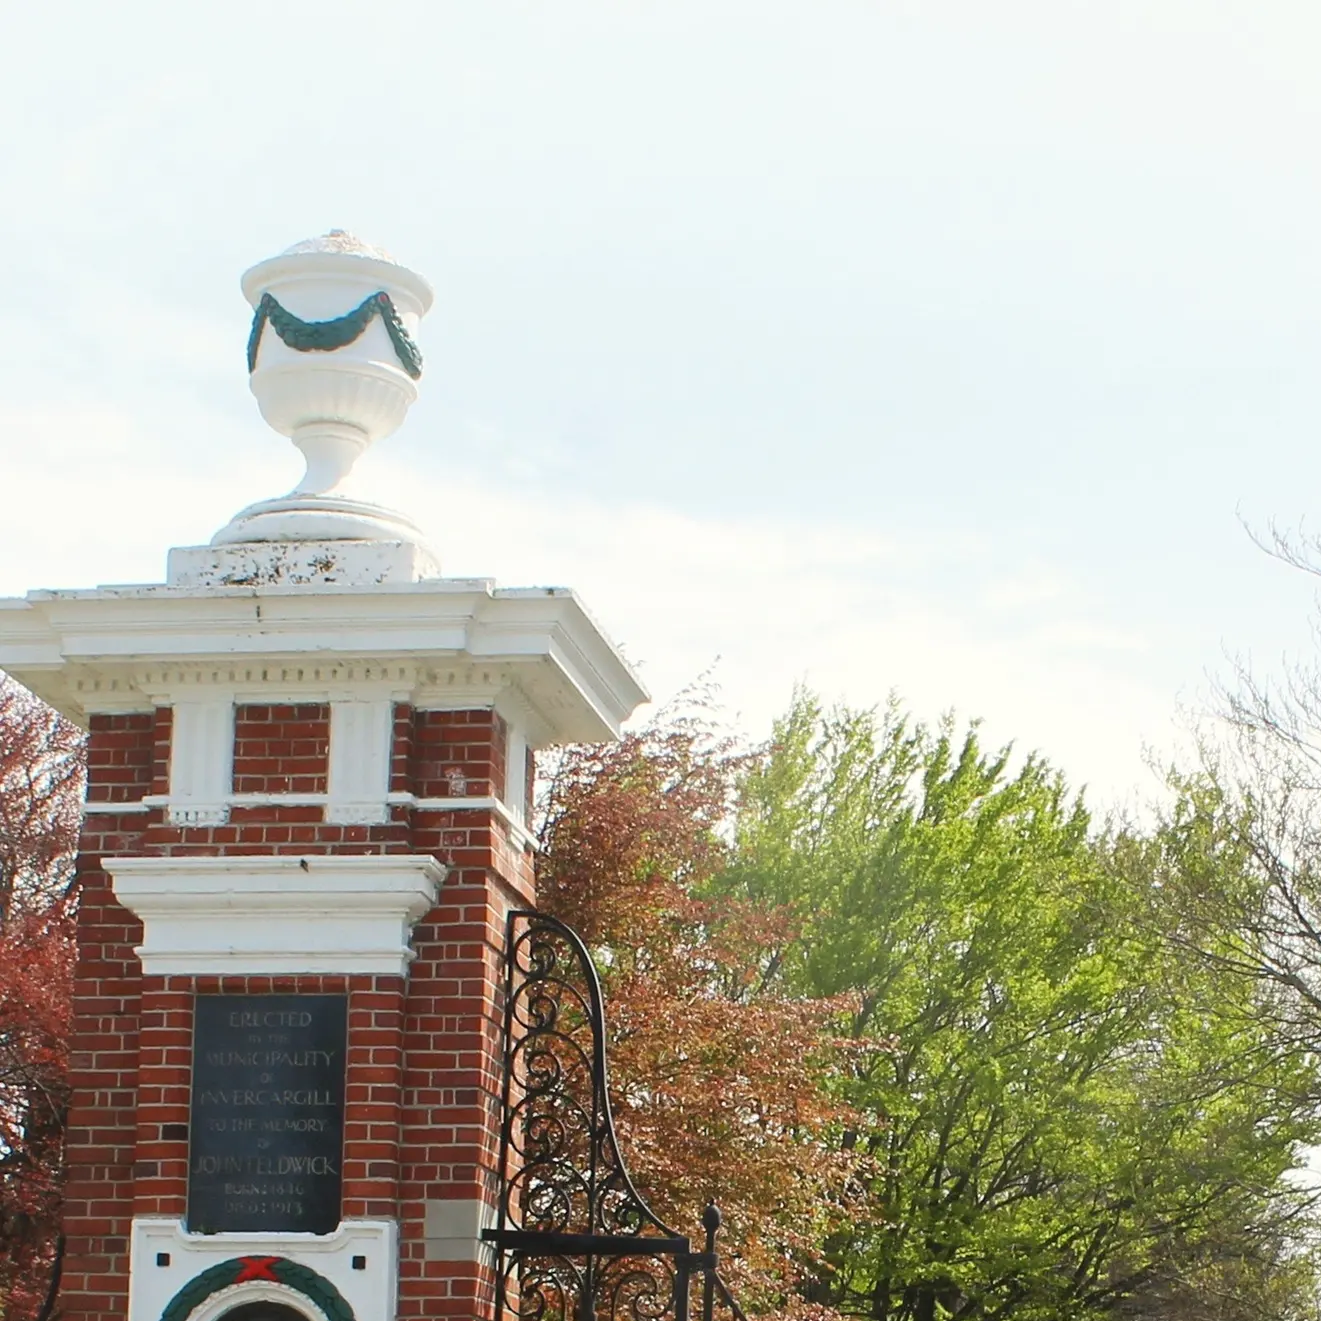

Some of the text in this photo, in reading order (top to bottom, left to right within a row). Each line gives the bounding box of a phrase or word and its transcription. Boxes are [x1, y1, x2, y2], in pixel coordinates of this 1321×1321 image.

[229, 1011, 313, 1028] ERECTED
[206, 1050, 336, 1068] MUNICIPALITY
[200, 1090, 336, 1106] INVERCARGILL
[260, 1118, 328, 1132] MEMORY
[194, 1156, 242, 1175] JOHN
